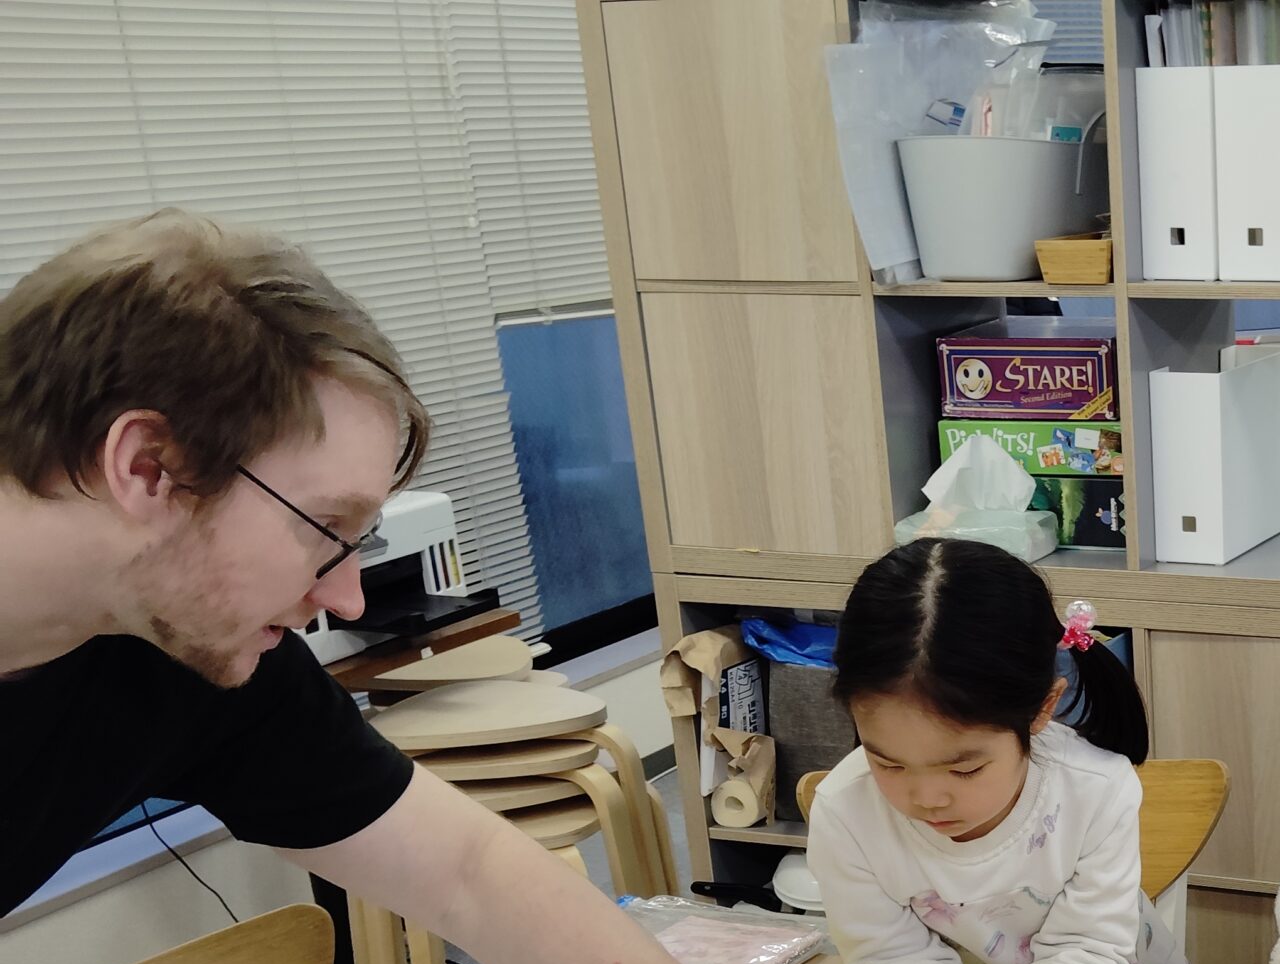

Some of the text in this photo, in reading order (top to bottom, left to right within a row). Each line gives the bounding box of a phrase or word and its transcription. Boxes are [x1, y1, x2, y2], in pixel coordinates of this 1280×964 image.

[996, 357, 1094, 394] STARE!
[1020, 390, 1073, 404] Second Edition
[946, 427, 1036, 456] PiiTS!
